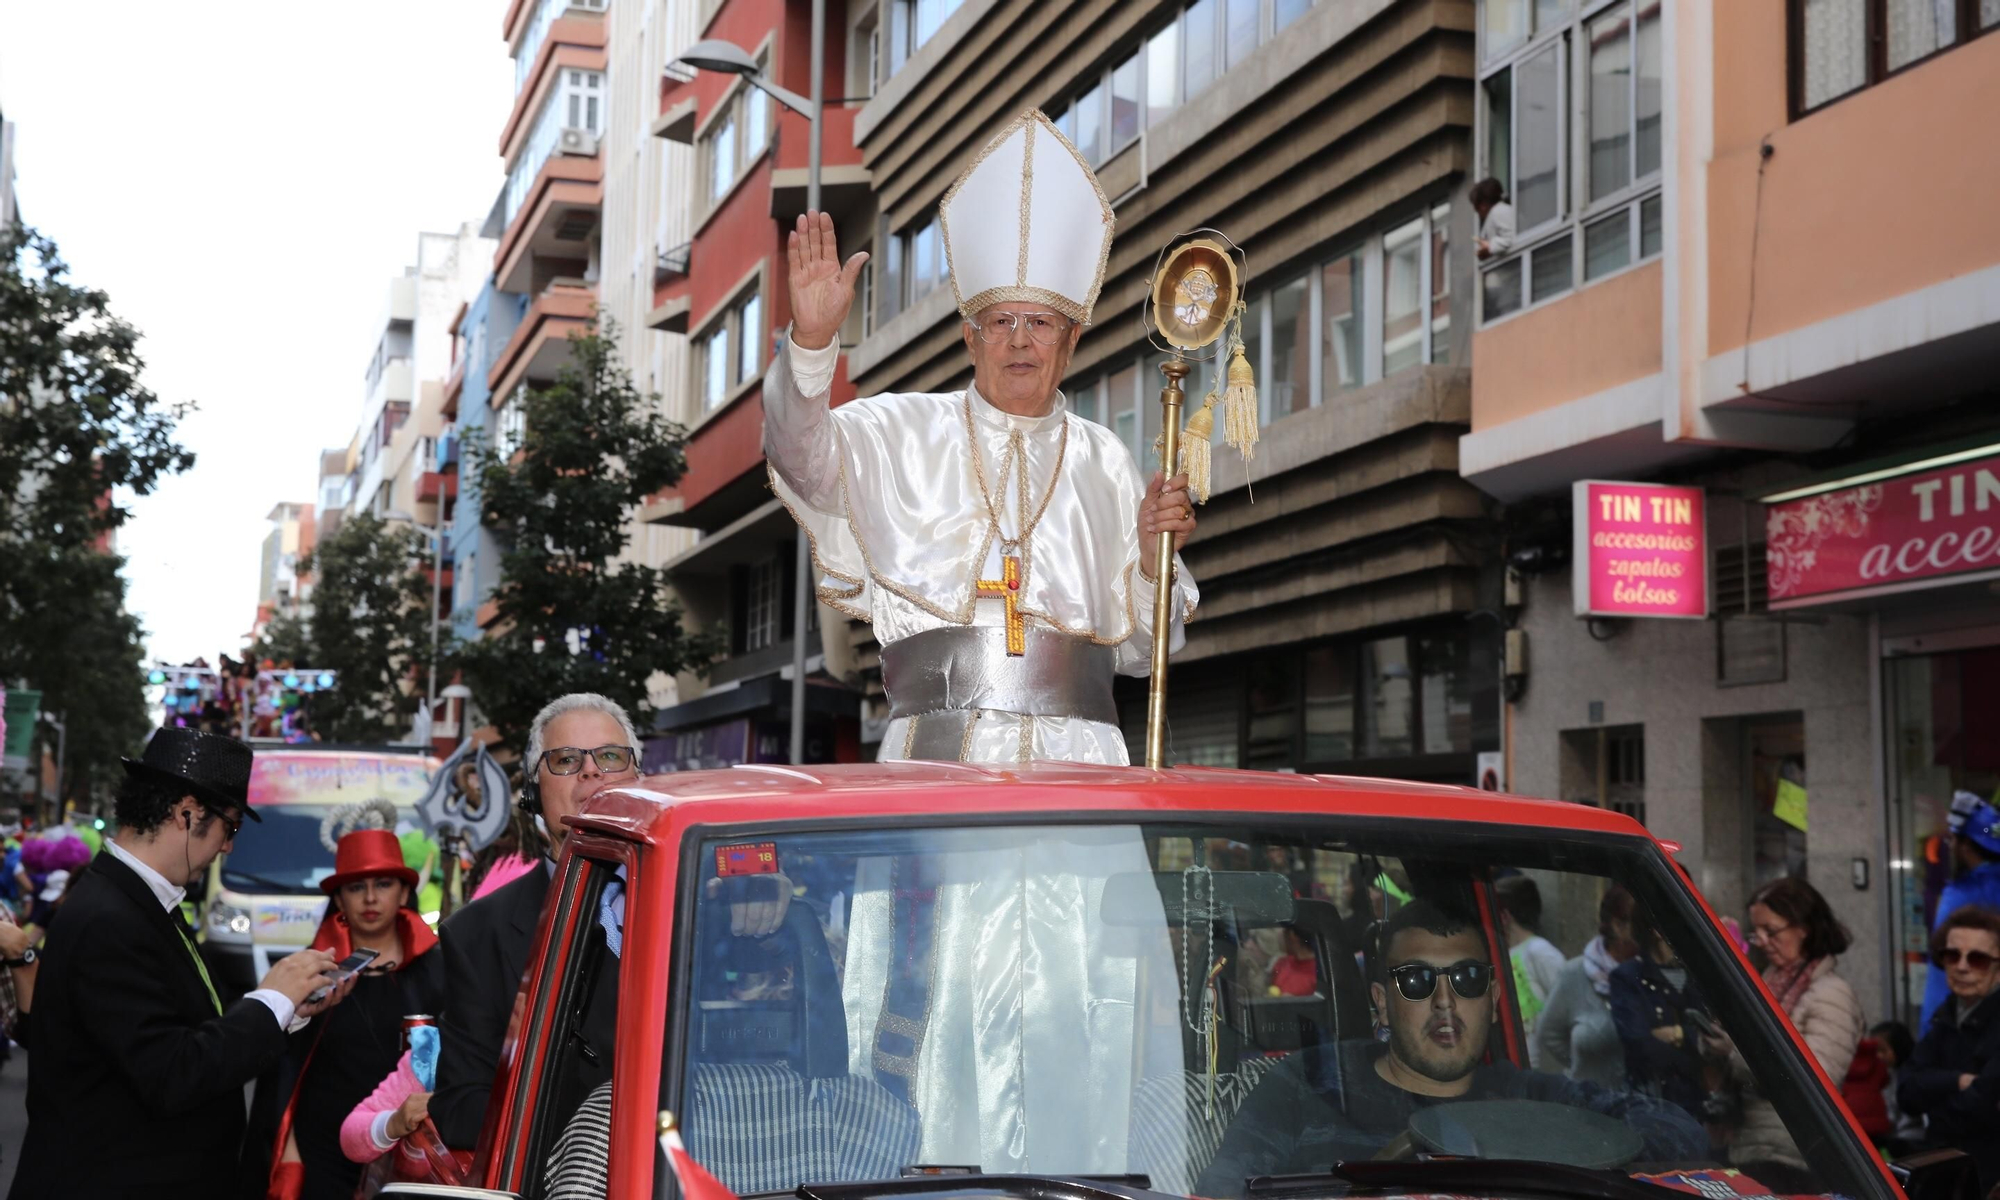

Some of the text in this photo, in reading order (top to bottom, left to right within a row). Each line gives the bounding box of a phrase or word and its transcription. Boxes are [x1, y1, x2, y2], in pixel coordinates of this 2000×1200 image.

[1600, 494, 1691, 525] TIN TIN
[1593, 530, 1696, 551] accesorios
[1859, 526, 2000, 579] acce
[1607, 556, 1684, 583] zapatos
[1613, 580, 1679, 605] bolsos
[758, 852, 773, 862] 18
